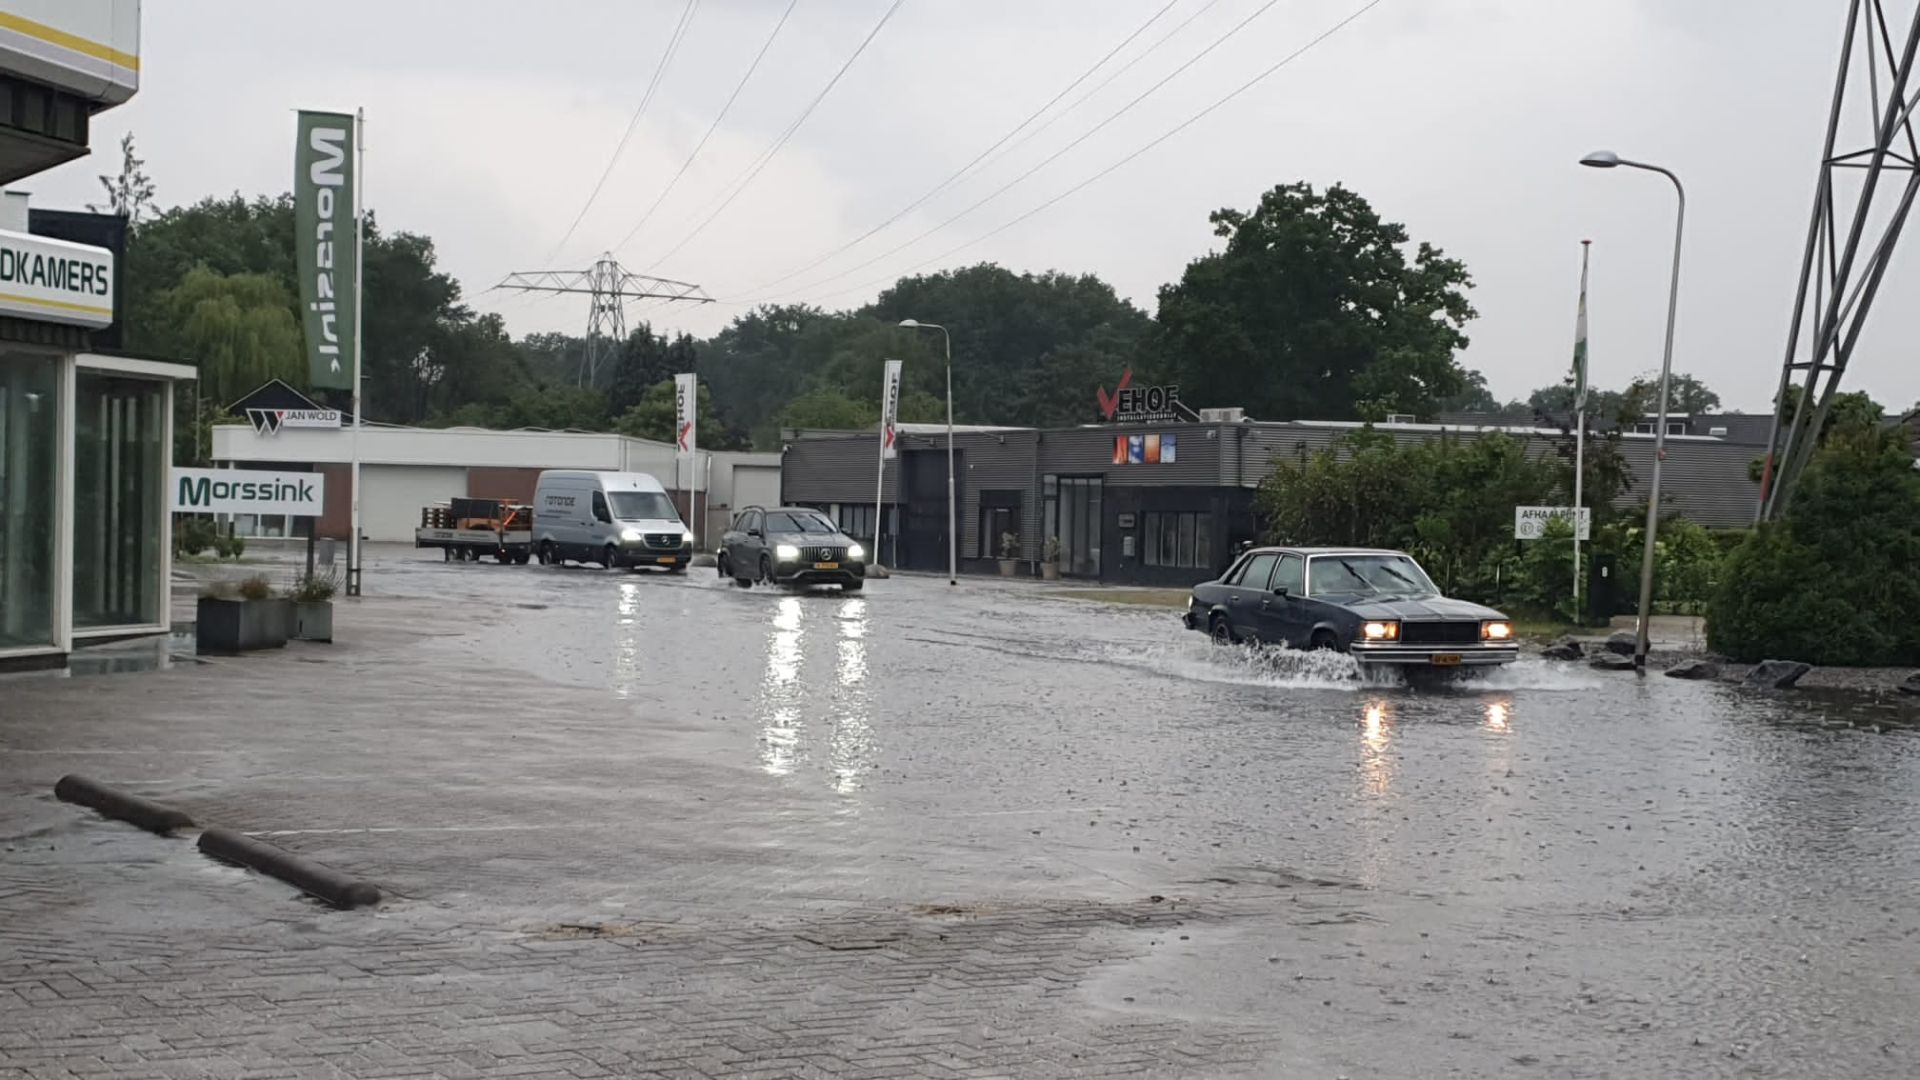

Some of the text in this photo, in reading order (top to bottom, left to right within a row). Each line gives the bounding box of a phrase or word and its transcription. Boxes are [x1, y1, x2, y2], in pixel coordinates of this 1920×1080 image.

[0, 248, 108, 296] DKAMERS
[1097, 368, 1179, 420] VEHOF
[285, 411, 305, 420] JAN
[307, 411, 337, 421] WOLD
[179, 476, 313, 506] Morssink
